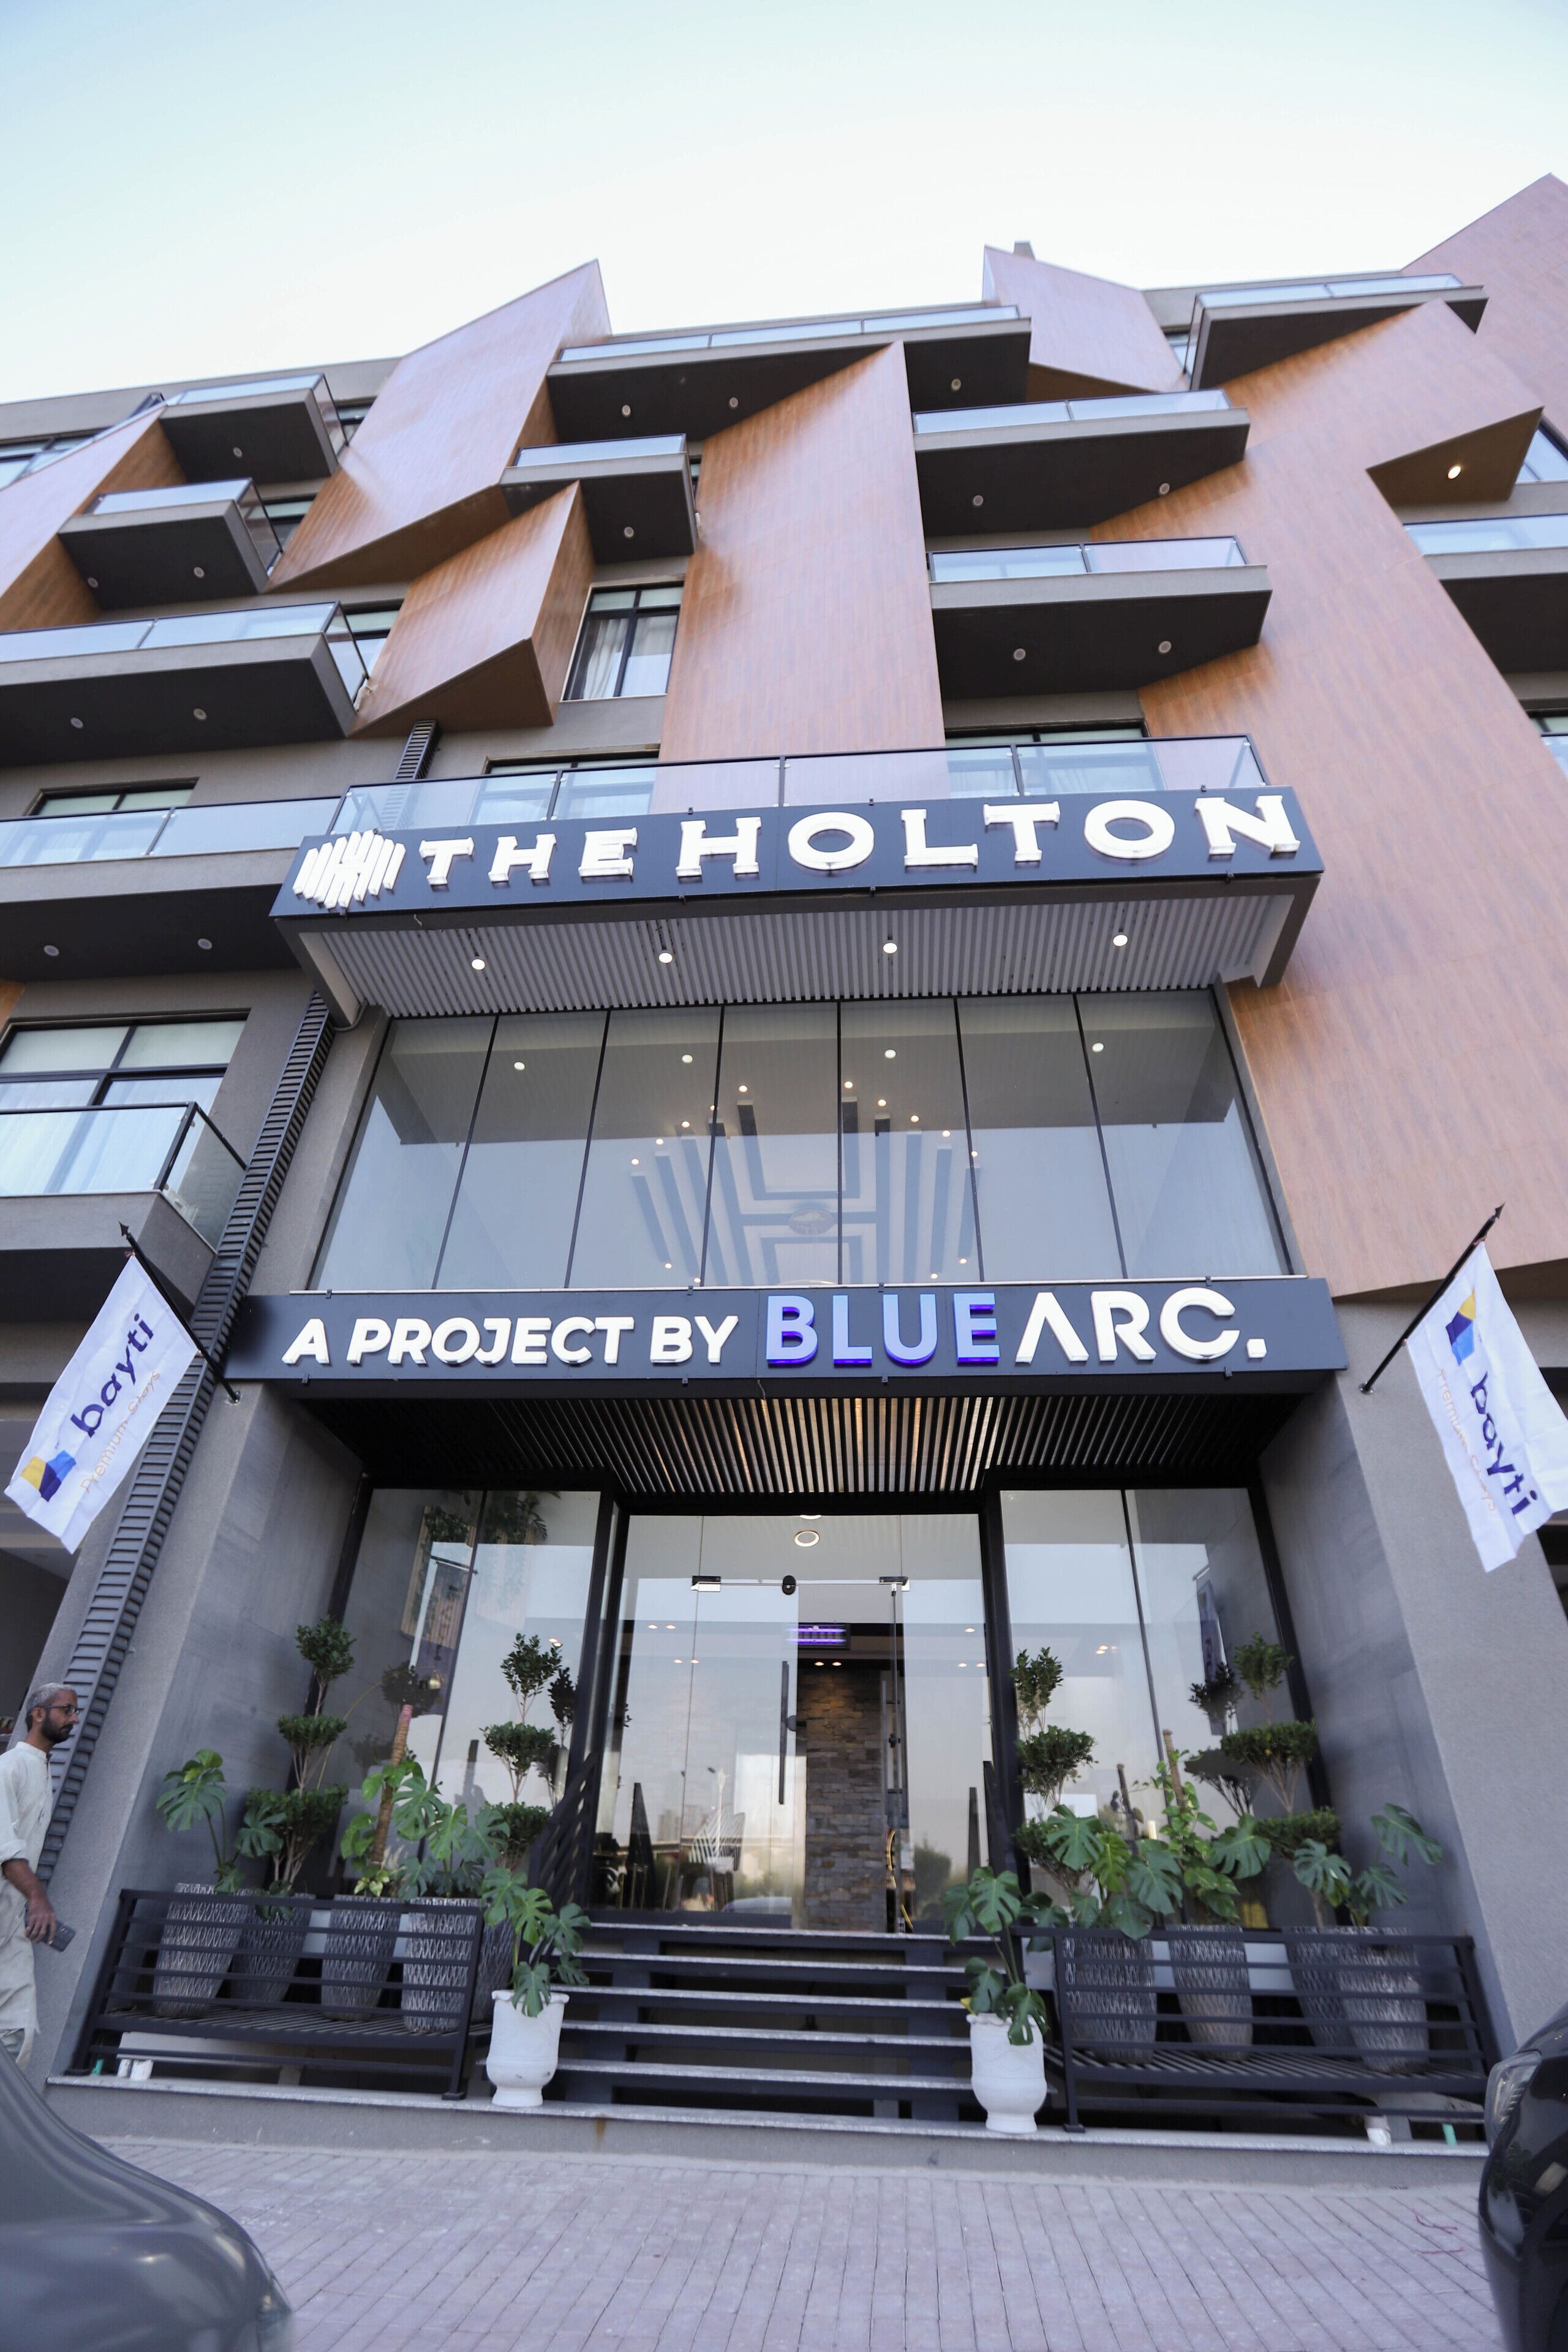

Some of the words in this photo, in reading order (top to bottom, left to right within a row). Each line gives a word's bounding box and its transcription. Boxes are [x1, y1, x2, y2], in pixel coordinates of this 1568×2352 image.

[419, 827, 638, 886] THE
[675, 795, 1301, 878] HOLTON
[281, 1318, 329, 1365] A
[346, 1316, 635, 1365] PROJECT
[650, 1315, 738, 1363] BY
[766, 1292, 1001, 1365] BLUE
[70, 1313, 154, 1438] bayti
[80, 1420, 128, 1493] Premium
[1470, 1370, 1538, 1515] bayti
